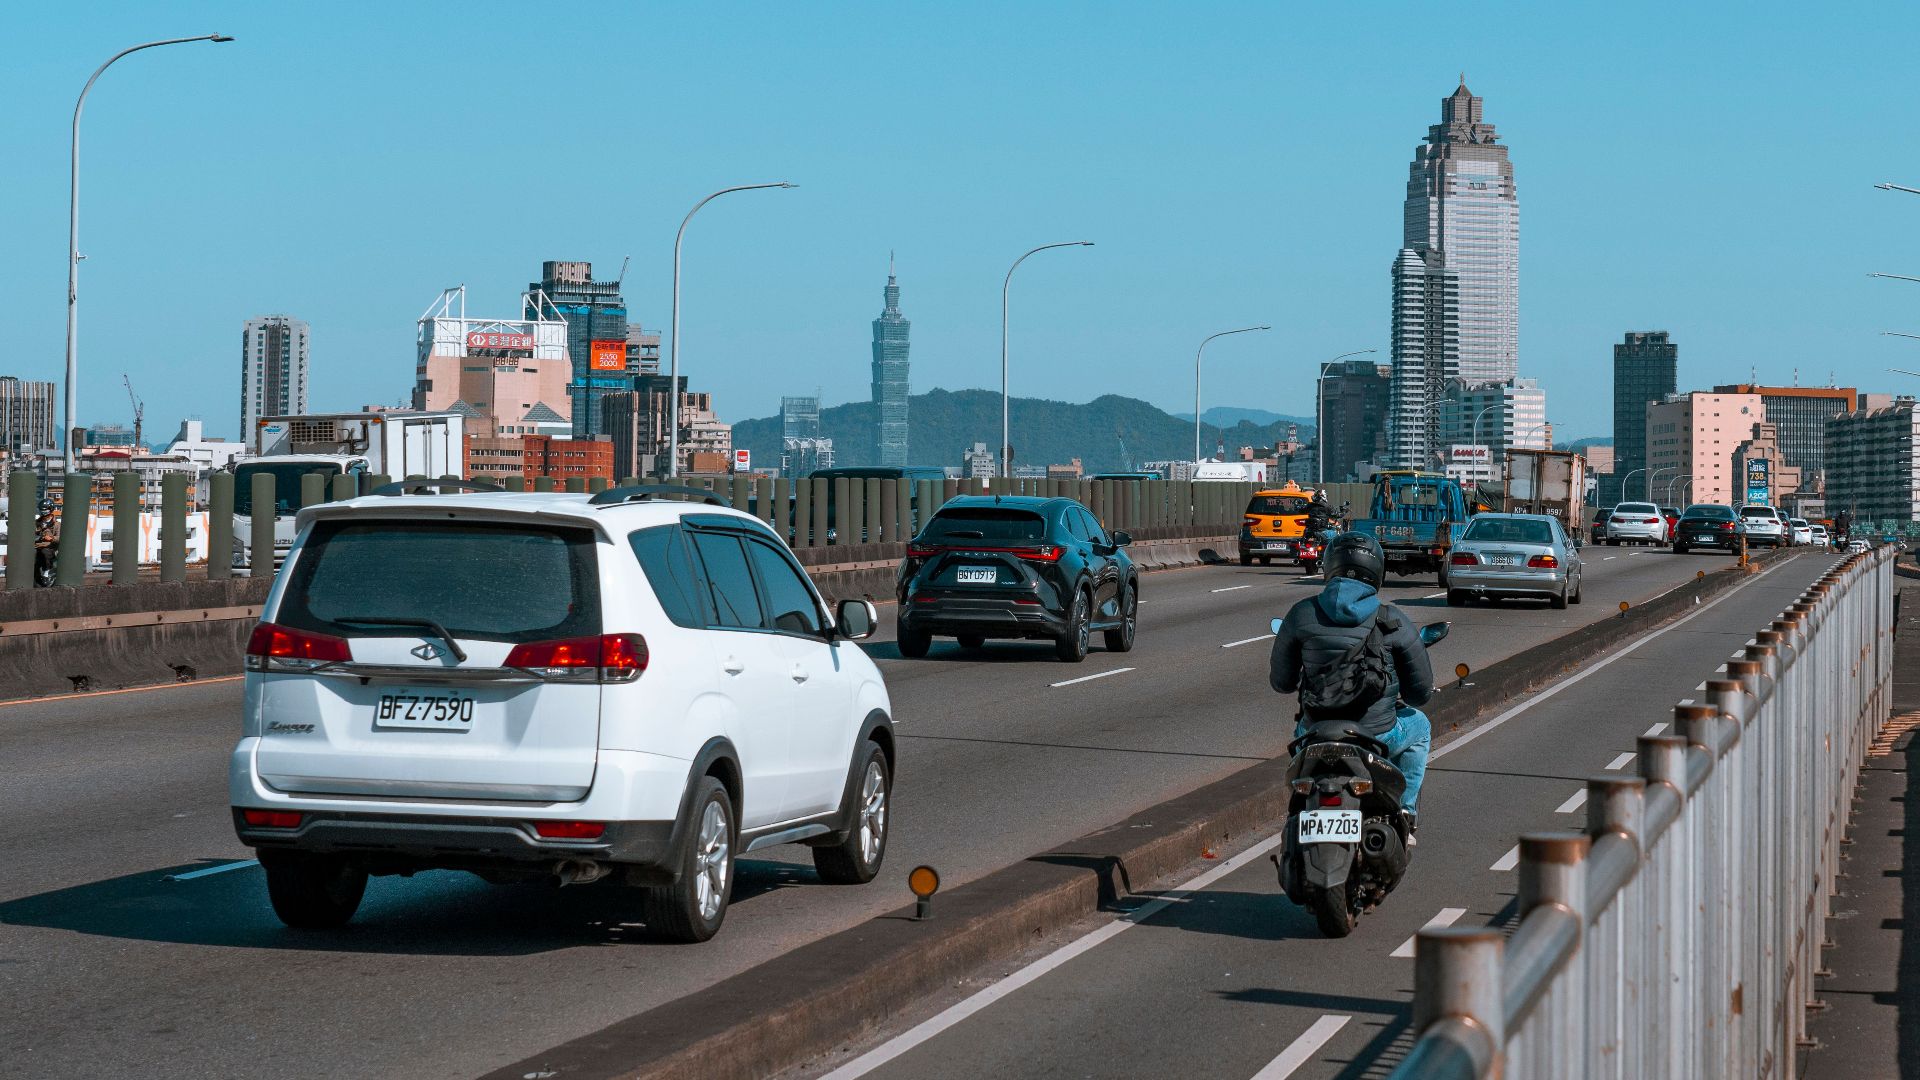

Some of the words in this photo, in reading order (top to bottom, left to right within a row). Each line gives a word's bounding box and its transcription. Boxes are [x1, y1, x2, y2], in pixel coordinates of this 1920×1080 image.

[1453, 449, 1486, 457] SANUX
[1749, 472, 1764, 480] 738
[1514, 506, 1527, 514] KPA
[1546, 508, 1563, 516] 9597
